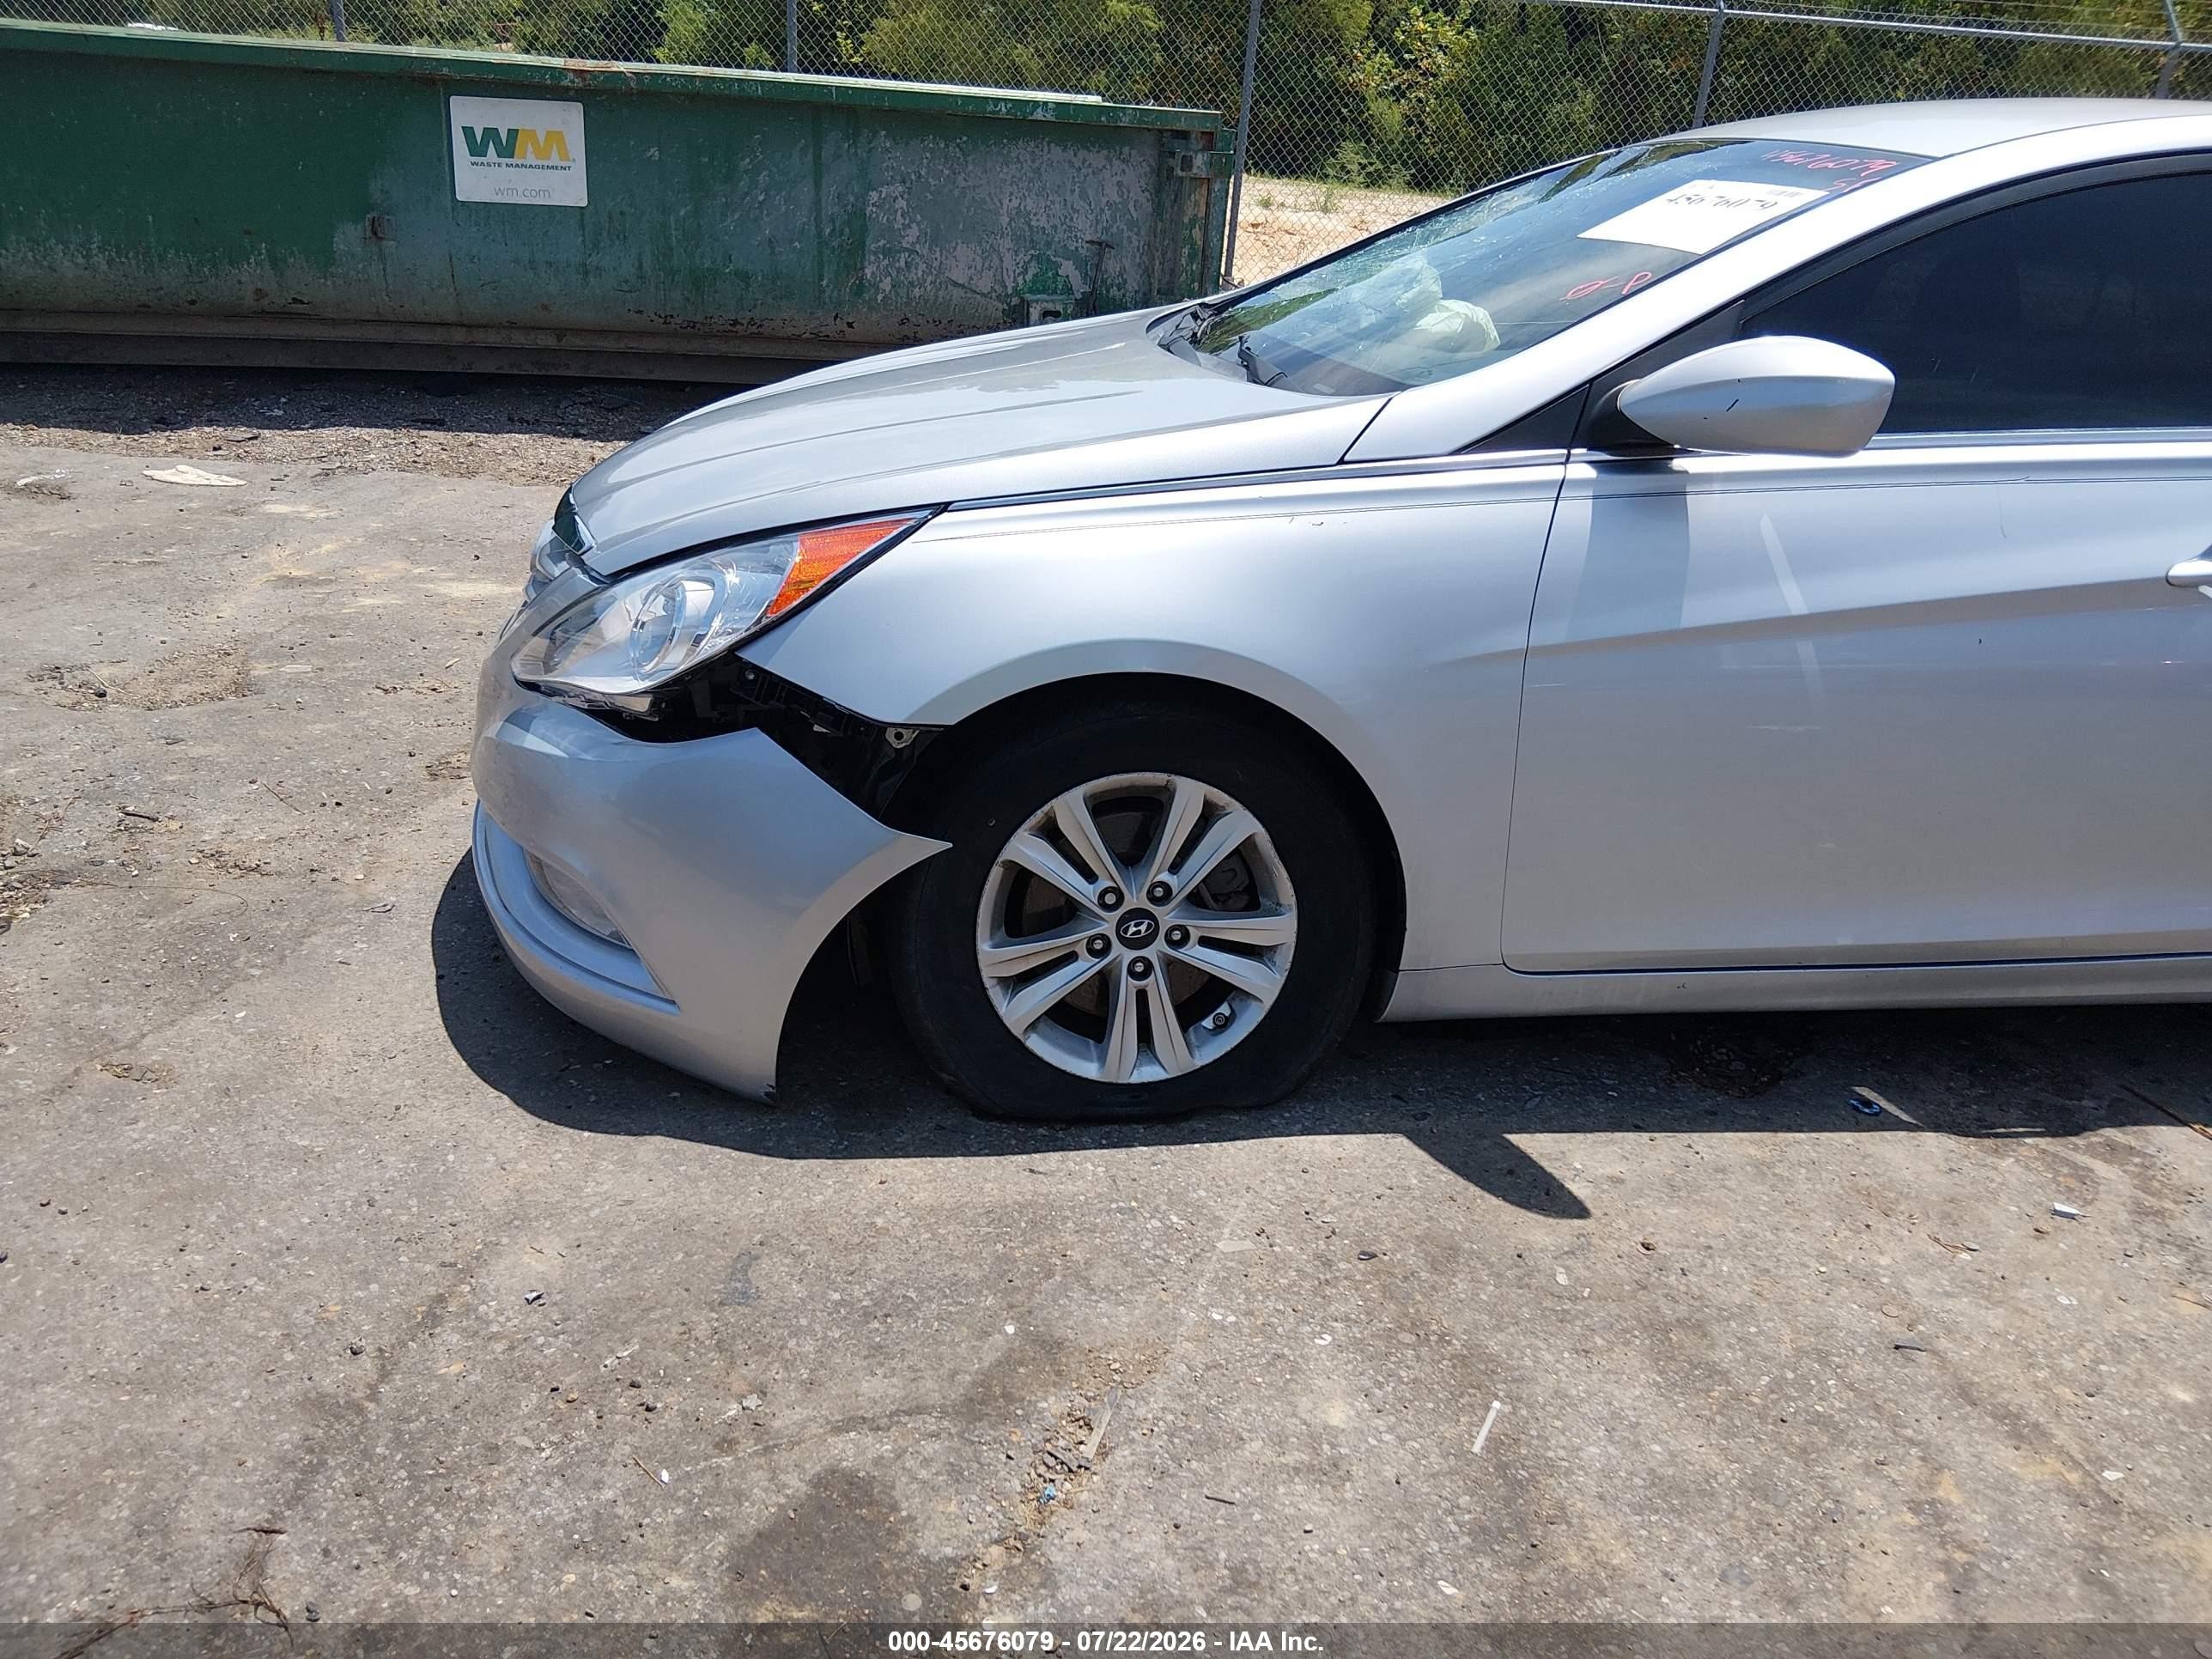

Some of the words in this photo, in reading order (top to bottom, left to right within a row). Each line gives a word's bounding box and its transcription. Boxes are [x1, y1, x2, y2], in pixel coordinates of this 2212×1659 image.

[461, 126, 571, 161] WM
[505, 162, 572, 171] MANAGEMENT
[494, 186, 550, 198] wm.com
